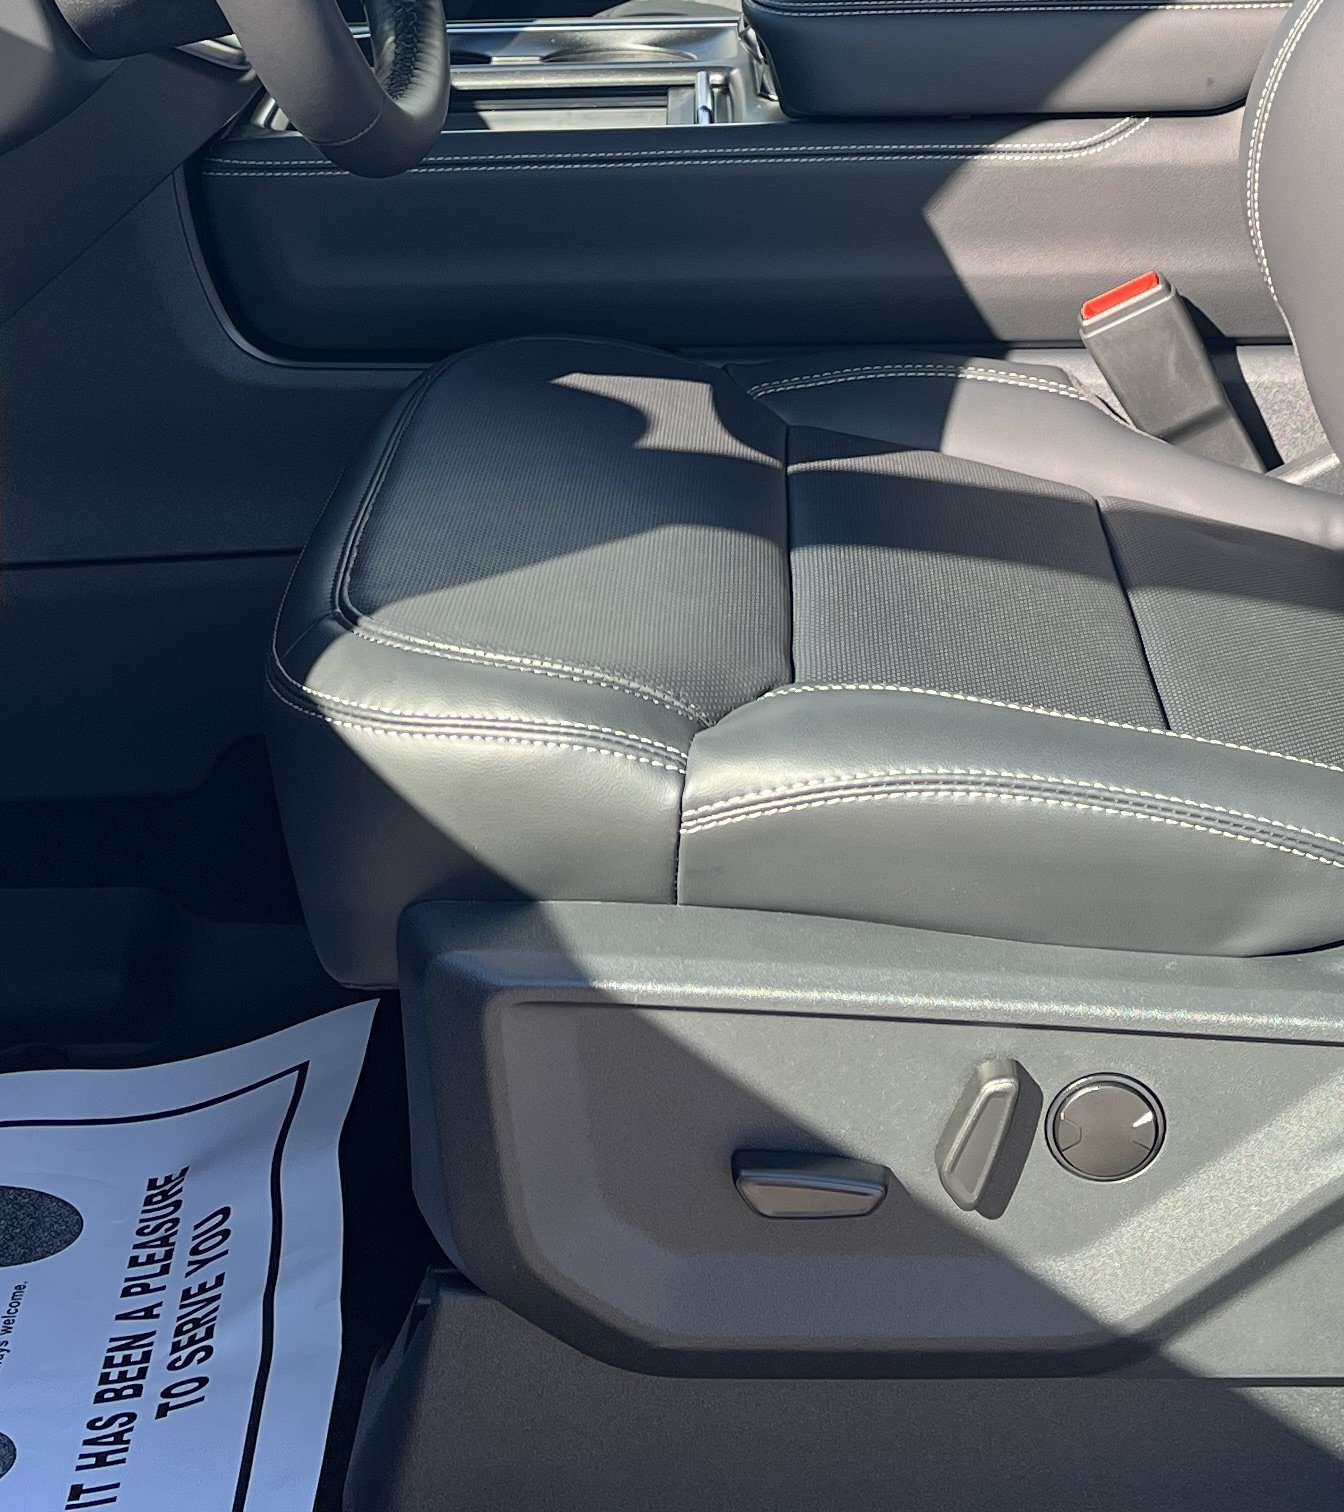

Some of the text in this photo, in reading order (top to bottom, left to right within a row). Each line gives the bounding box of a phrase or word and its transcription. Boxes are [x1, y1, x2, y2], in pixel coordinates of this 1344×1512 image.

[0, 1280, 28, 1338] welcome.
[65, 1165, 190, 1511] IT HAS BEEN A PLEASURE
[155, 1206, 231, 1420] TO SERVE YOU
